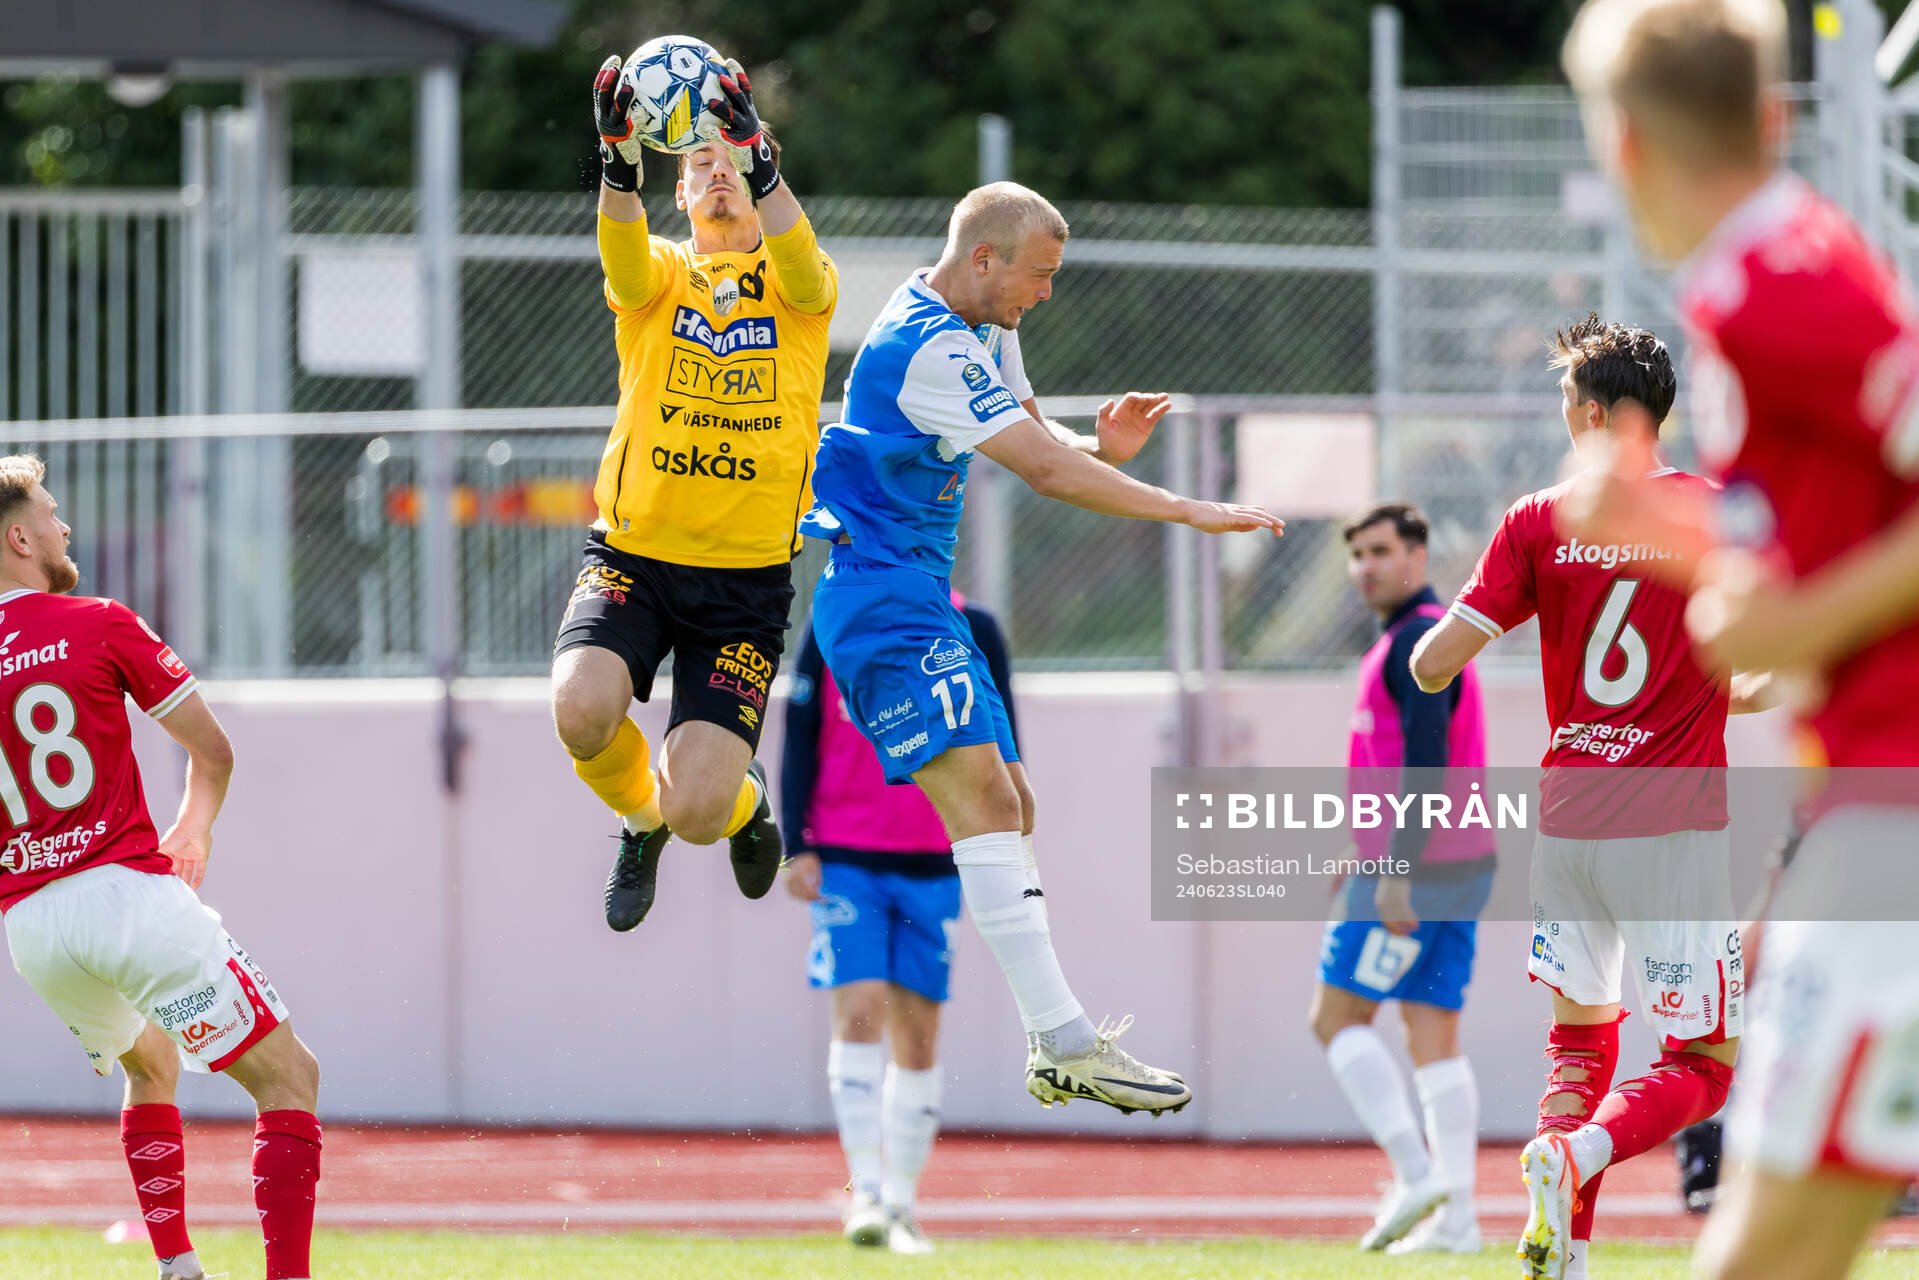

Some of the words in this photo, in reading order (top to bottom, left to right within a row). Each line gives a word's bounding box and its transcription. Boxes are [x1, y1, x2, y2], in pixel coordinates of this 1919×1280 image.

[684, 411, 782, 432] VÄSTANHEDE
[651, 442, 757, 481] askås
[0, 638, 69, 679] smat
[1584, 578, 1650, 708] 6
[931, 672, 974, 730] 17
[155, 985, 216, 1018] factoring
[163, 999, 214, 1030] gruppen
[232, 999, 250, 1026] umbro
[181, 1020, 218, 1045] ICA
